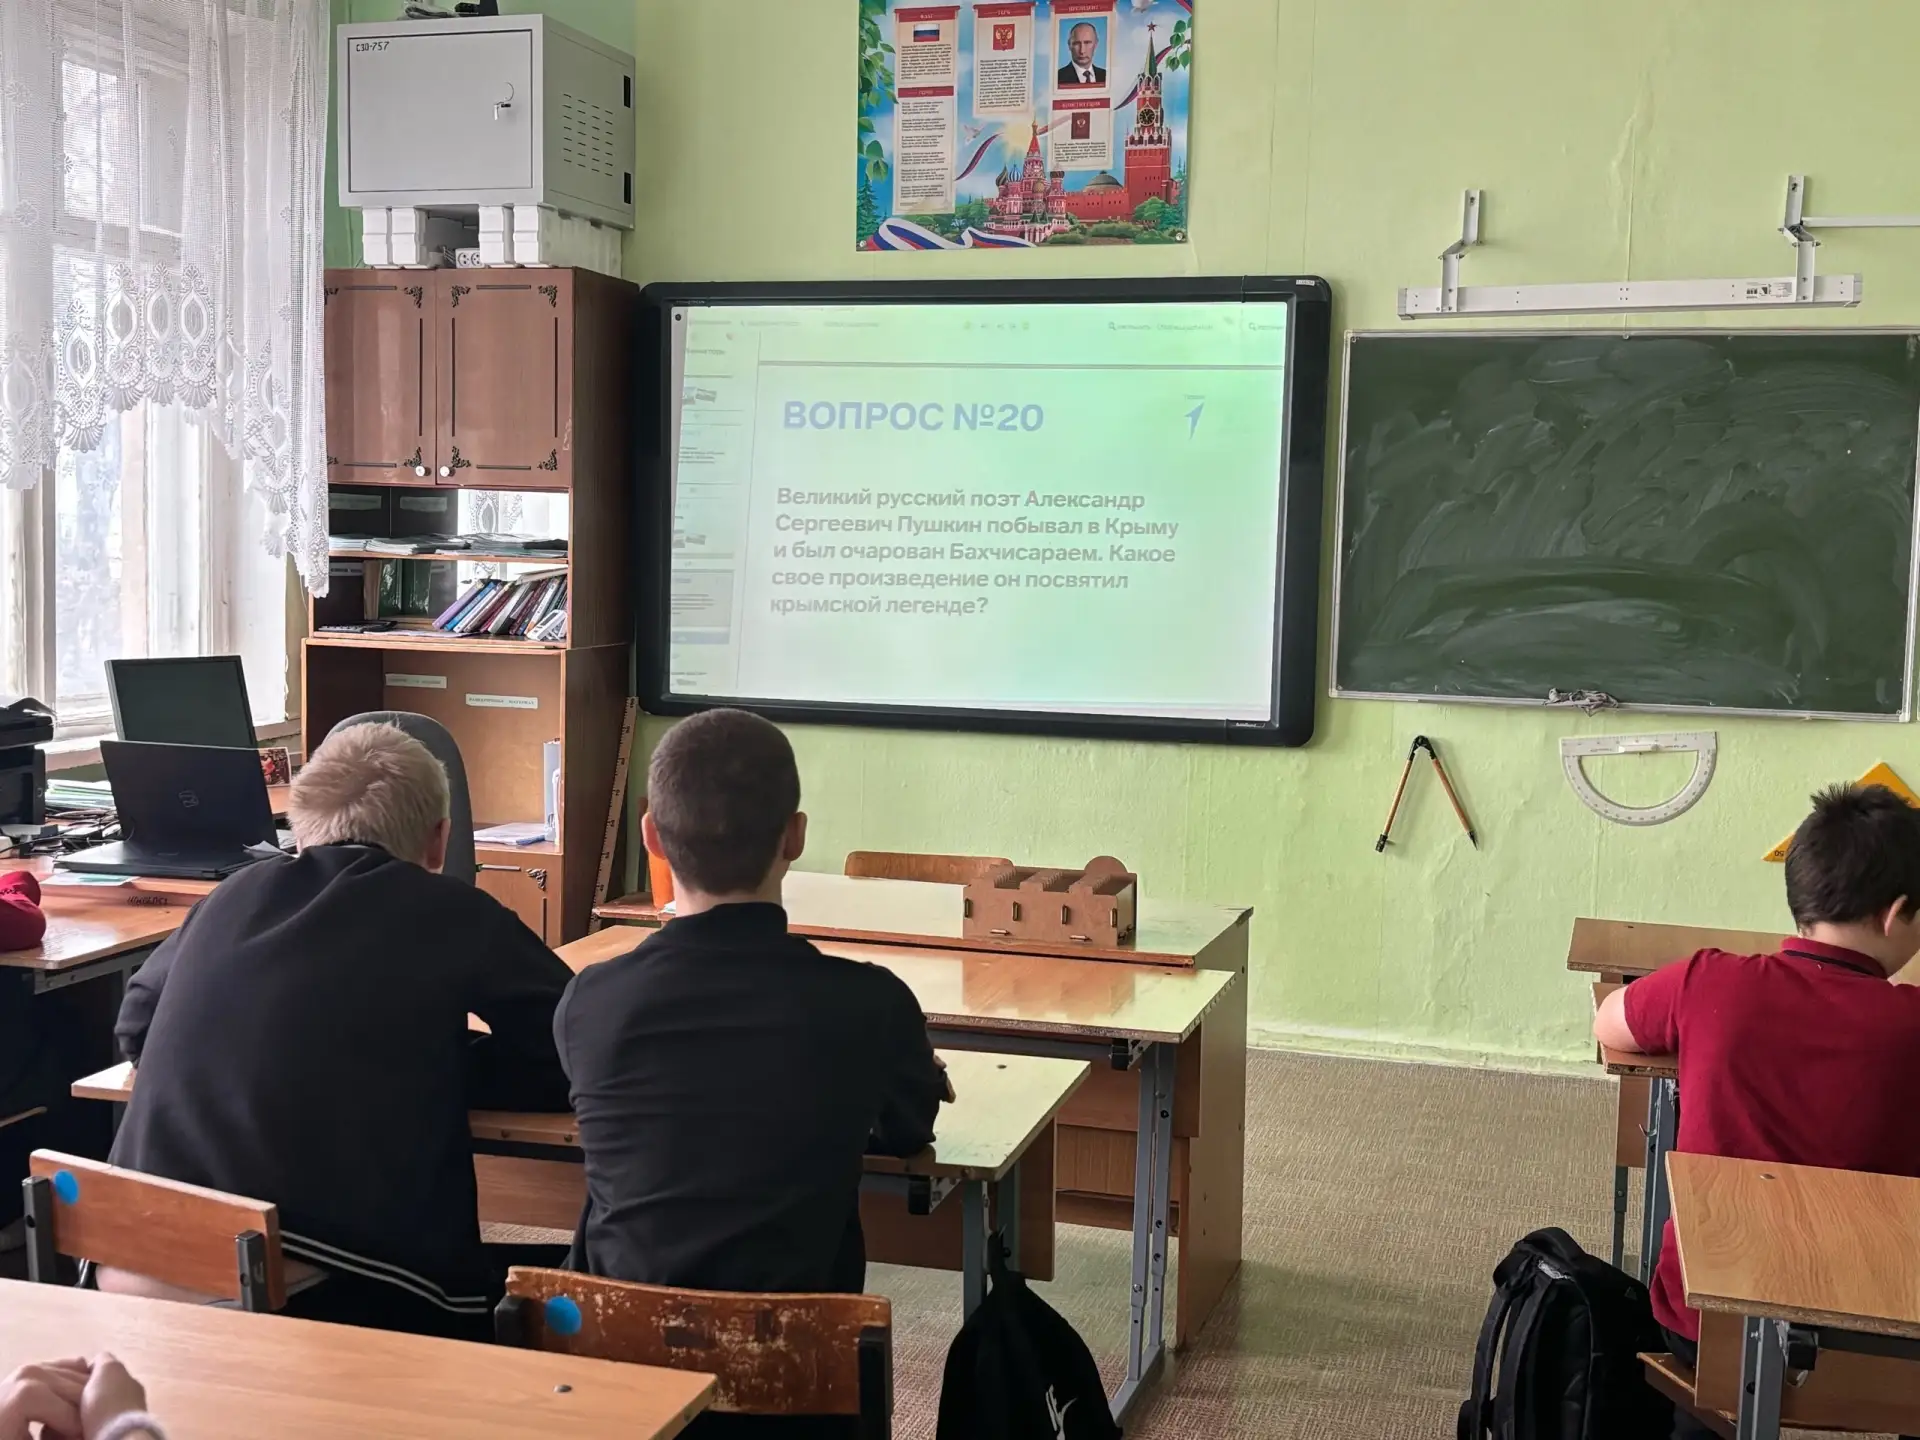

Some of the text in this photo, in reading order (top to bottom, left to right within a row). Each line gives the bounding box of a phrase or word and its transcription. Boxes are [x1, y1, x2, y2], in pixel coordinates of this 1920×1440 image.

[784, 401, 1043, 431] ВОПРОС №20
[777, 488, 1145, 512] Великий русский поэт Александр
[776, 514, 1179, 539] Сергеевич Пушкин побывал в Крыму
[774, 540, 1175, 565] и был очарован Бахчисараем. Какое
[772, 572, 1128, 589] свое произведение он посвятил
[771, 595, 988, 616] крымской легенде?
